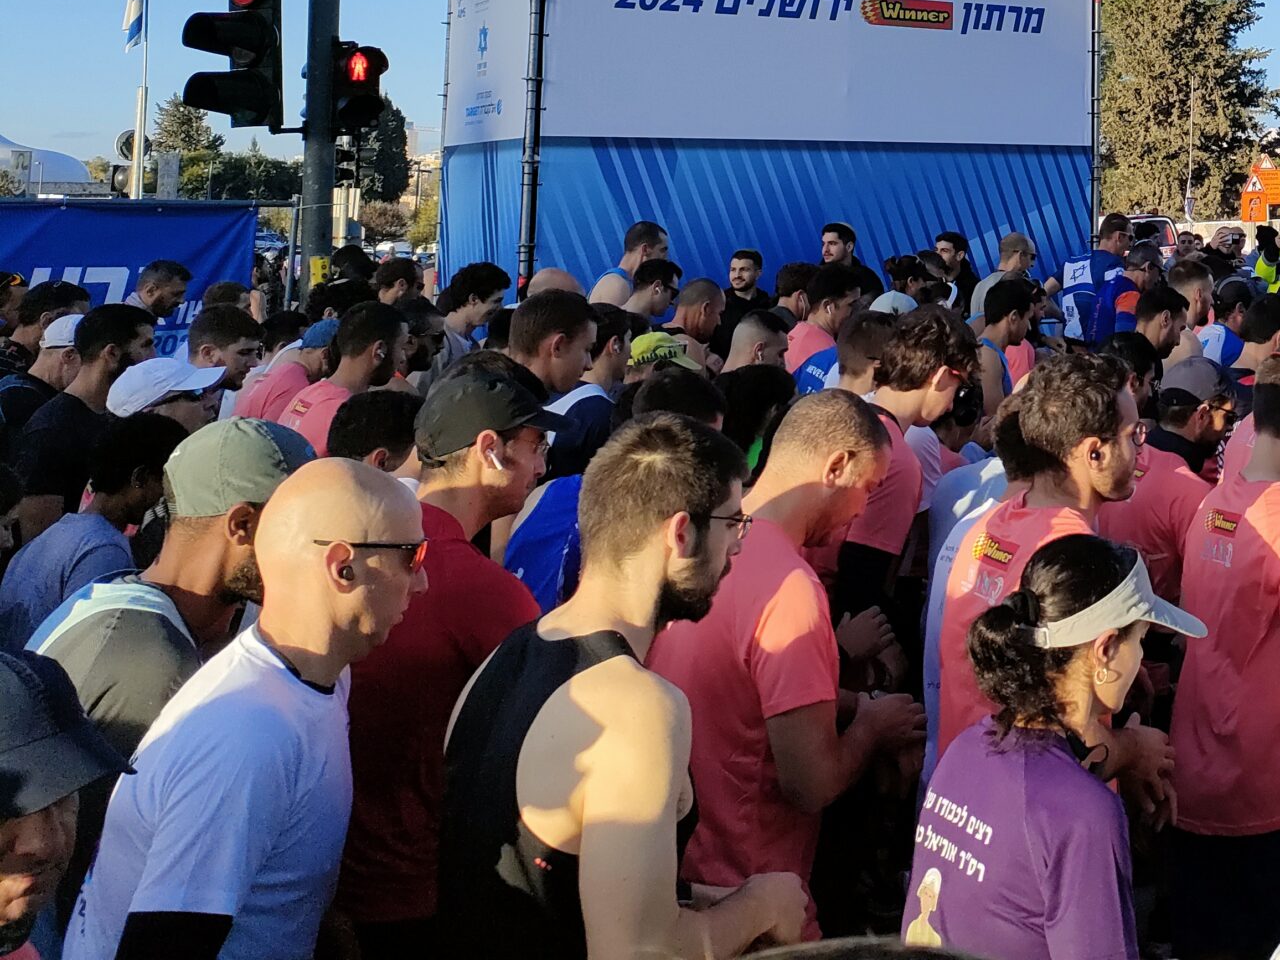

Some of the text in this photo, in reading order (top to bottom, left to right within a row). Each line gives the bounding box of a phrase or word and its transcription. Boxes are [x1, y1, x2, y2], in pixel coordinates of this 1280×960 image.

[879, 0, 950, 24] Winner
[960, 3, 1046, 35] מרתון
[984, 539, 1013, 564] Winner
[934, 796, 968, 828] לכבודו
[924, 824, 958, 863] אוריאל
[965, 815, 993, 845] רצים
